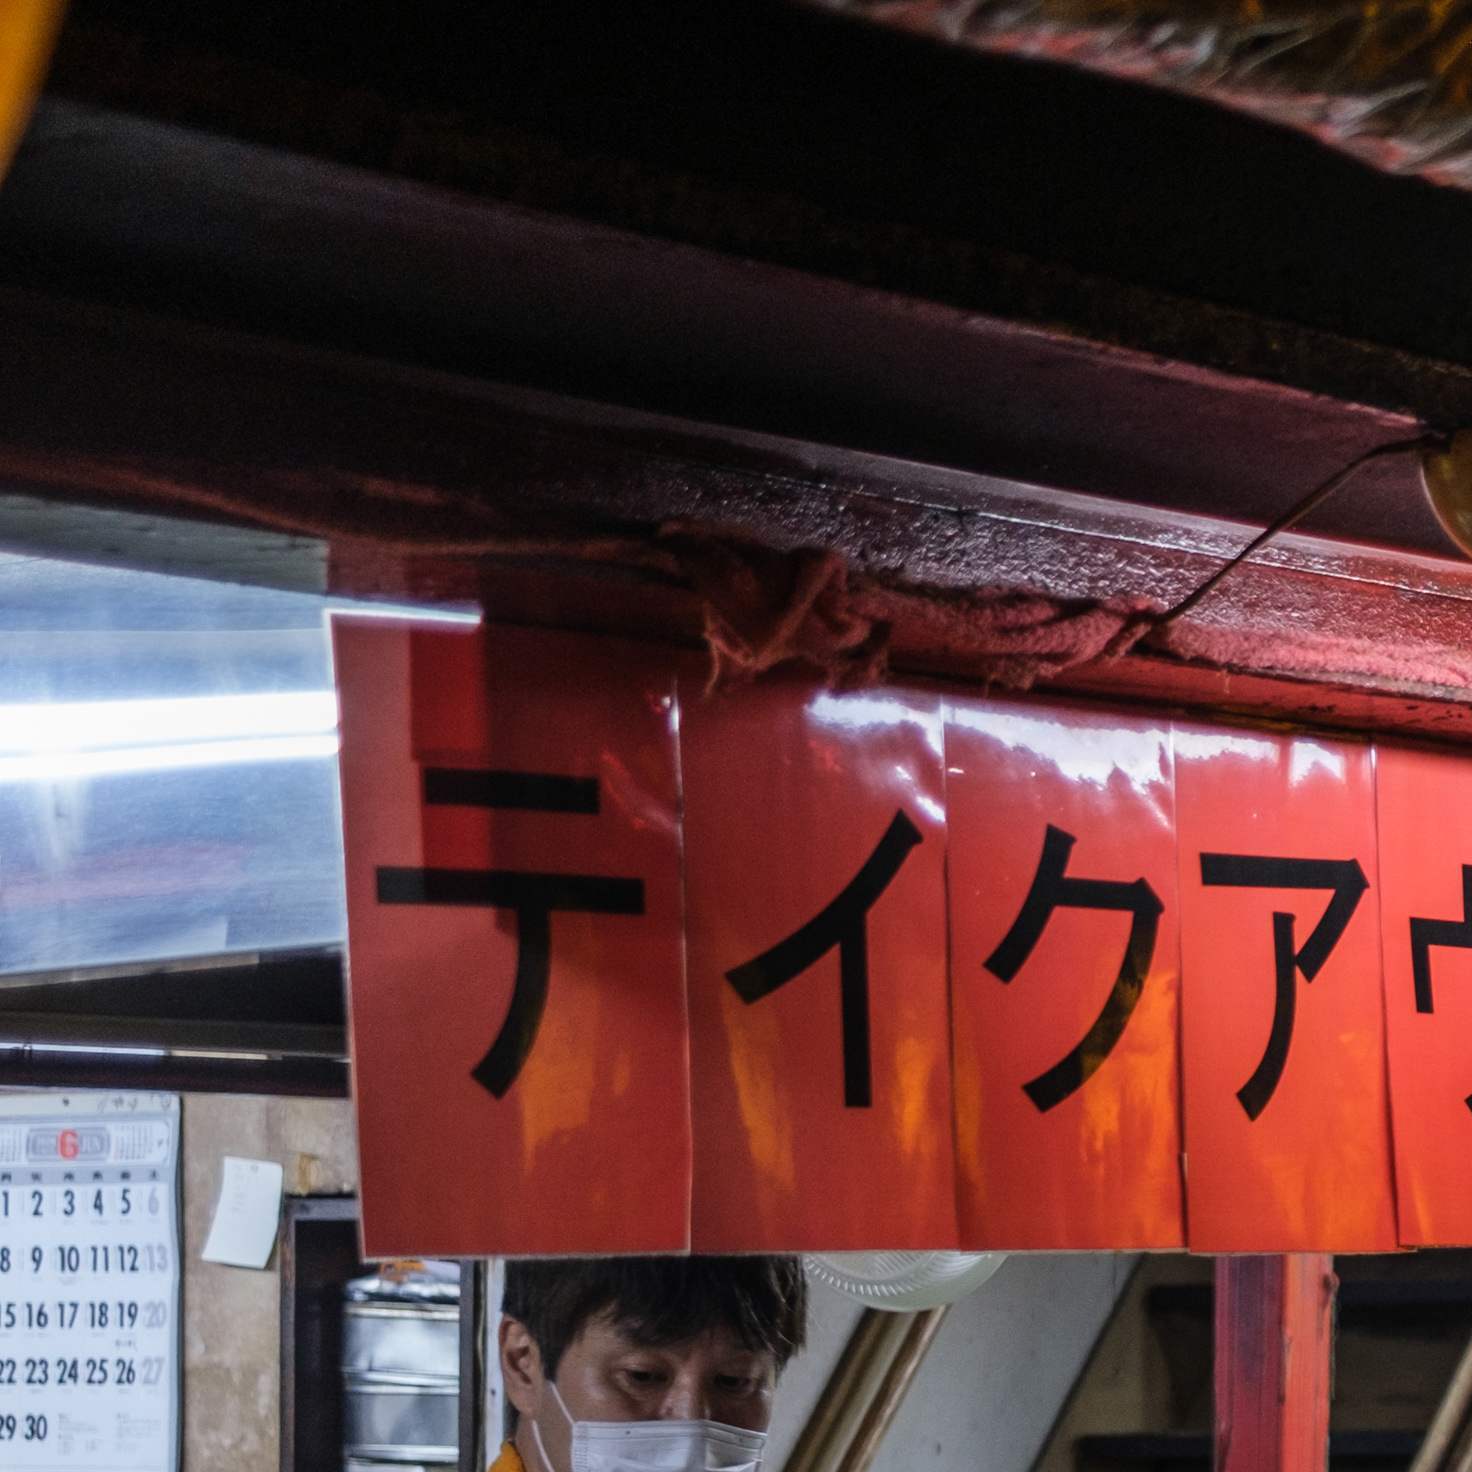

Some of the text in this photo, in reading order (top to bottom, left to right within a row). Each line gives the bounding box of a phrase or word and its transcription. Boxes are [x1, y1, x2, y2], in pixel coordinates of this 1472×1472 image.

[58, 1128, 79, 1160] 6
[31, 1190, 43, 1216] 2
[63, 1190, 75, 1216] 3
[93, 1188, 104, 1216] 4
[121, 1188, 131, 1214] 5
[149, 1186, 159, 1215] 6
[0, 1244, 167, 1273] 8 9 10 11 12 13
[0, 1301, 167, 1328] 5 16 17 18 19 20
[25, 1358, 49, 1385] 23
[57, 1358, 79, 1385] 24
[87, 1358, 108, 1385] 25
[116, 1359, 136, 1385] 26
[143, 1356, 165, 1385] 27
[25, 1414, 48, 1440] 30
